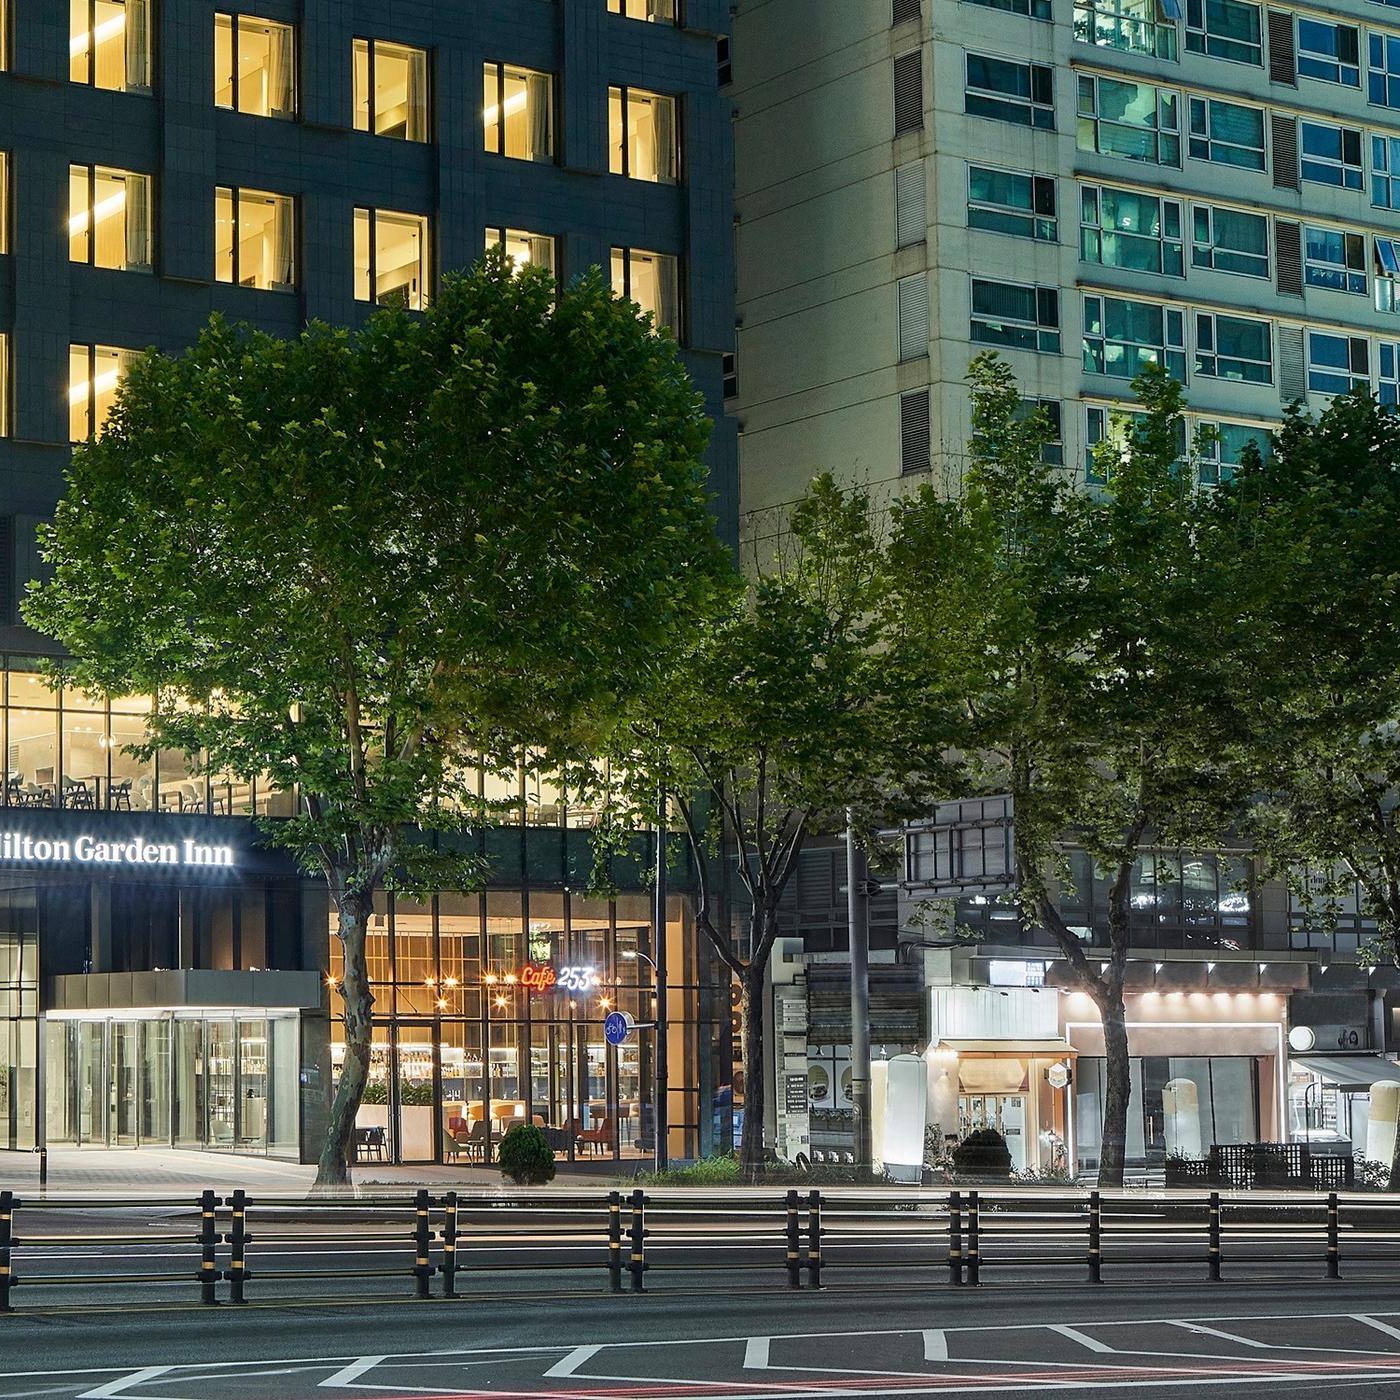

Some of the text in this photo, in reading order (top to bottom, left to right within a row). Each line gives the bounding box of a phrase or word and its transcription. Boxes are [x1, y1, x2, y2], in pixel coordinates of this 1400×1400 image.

[75, 837, 178, 864] Garden
[183, 840, 233, 865] Inn
[521, 966, 594, 991] Café 253
